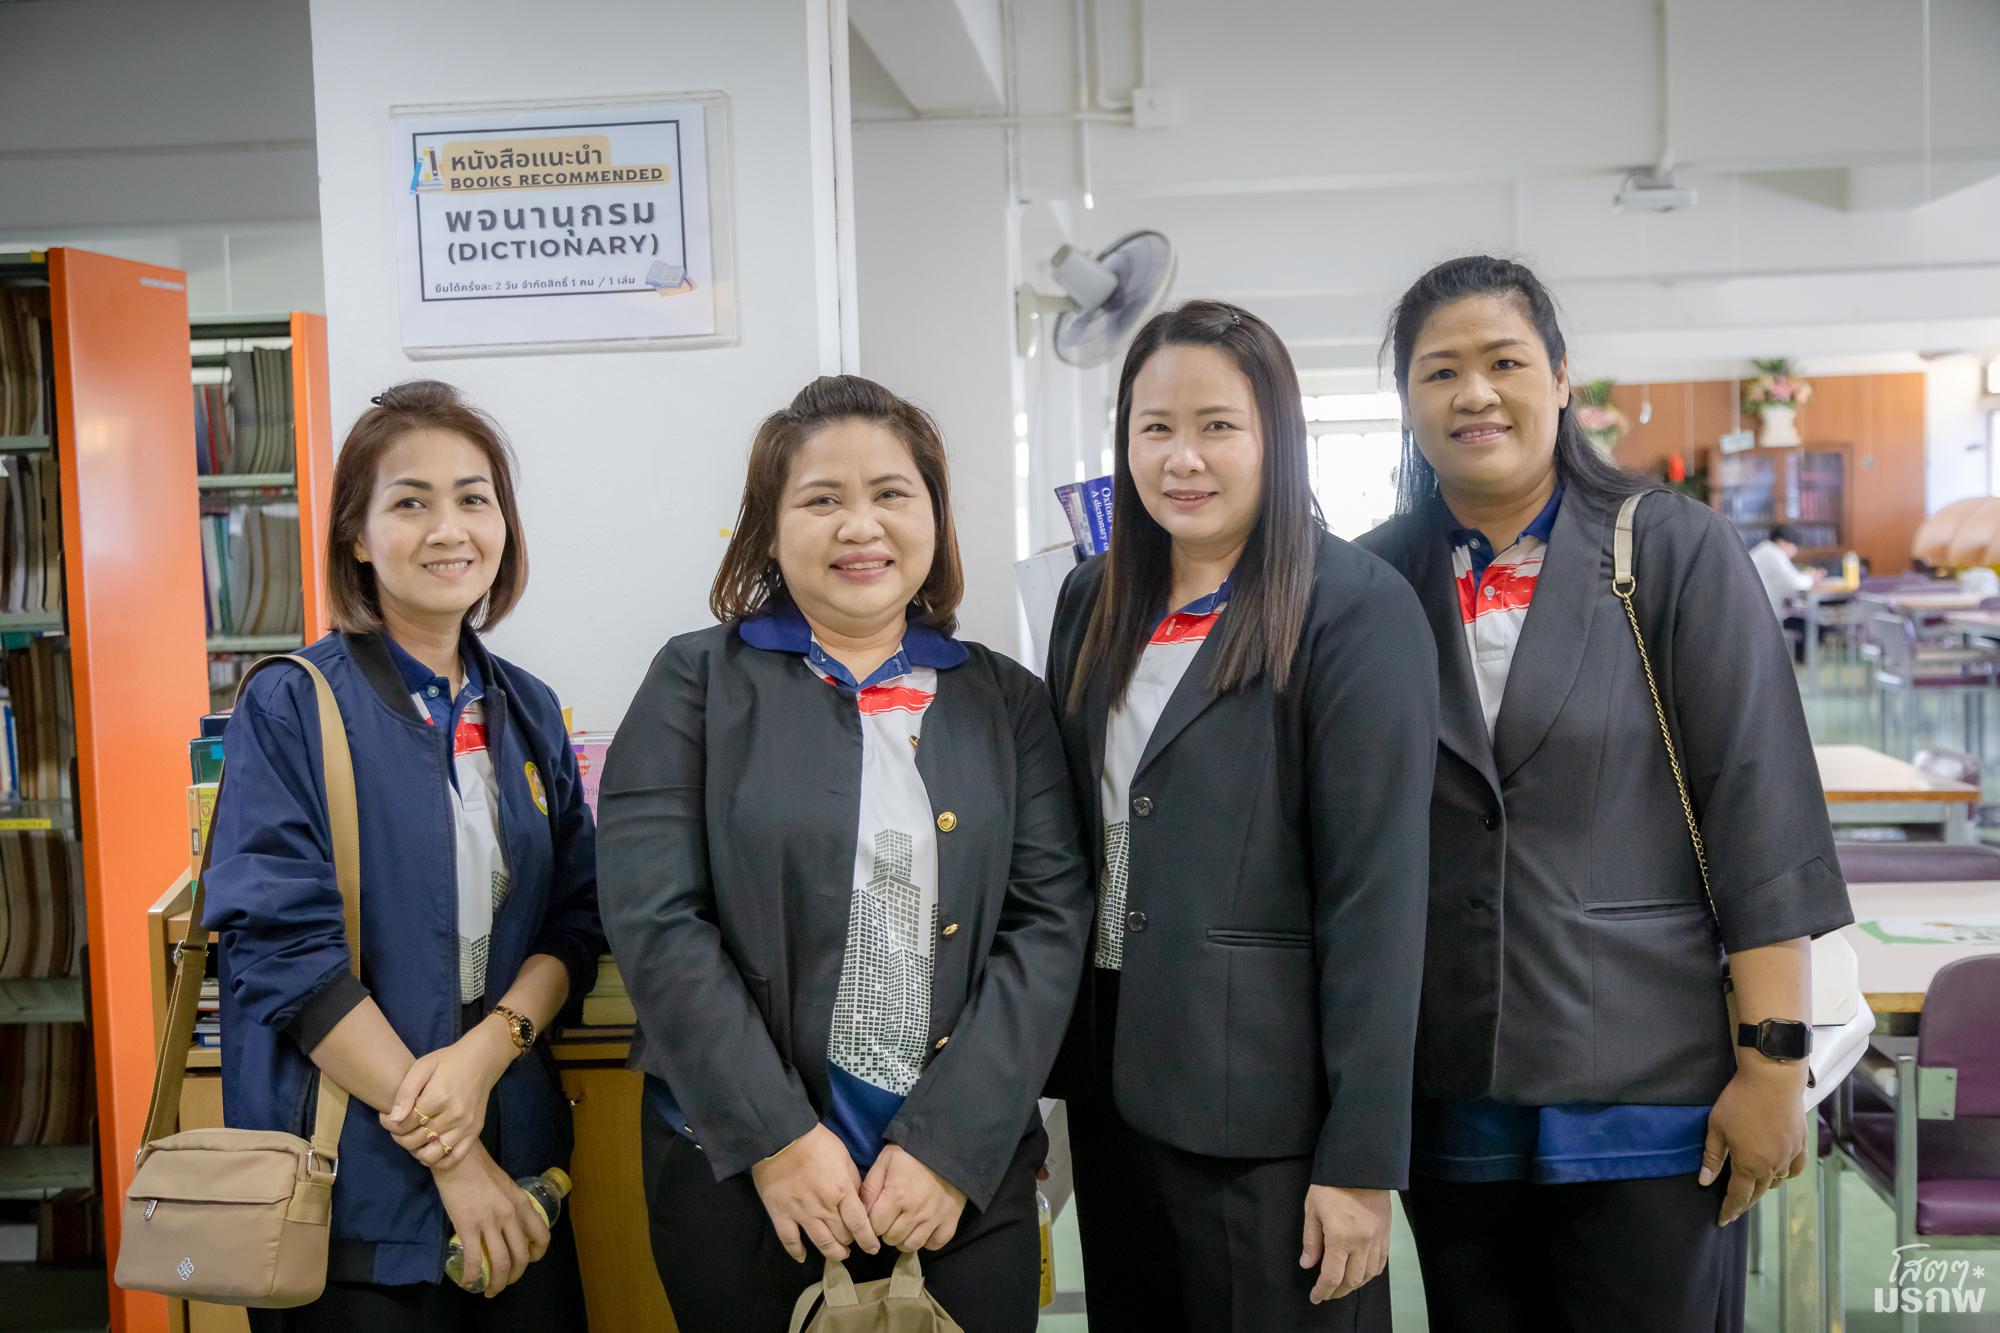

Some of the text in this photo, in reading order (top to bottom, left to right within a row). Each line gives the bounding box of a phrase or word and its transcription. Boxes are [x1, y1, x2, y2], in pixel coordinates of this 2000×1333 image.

[451, 143, 603, 171] หนังสือแนะนำ
[450, 168, 663, 189] BOOKS RECOMMENDED
[445, 202, 655, 237] พจนานุกรม
[448, 233, 659, 265] (DICTIONARY)
[496, 282, 501, 290] 2
[505, 280, 519, 290] วัน
[580, 279, 594, 287] คน
[617, 274, 636, 285] เล่ม
[1091, 490, 1100, 498] A
[1094, 499, 1108, 541] dictionary
